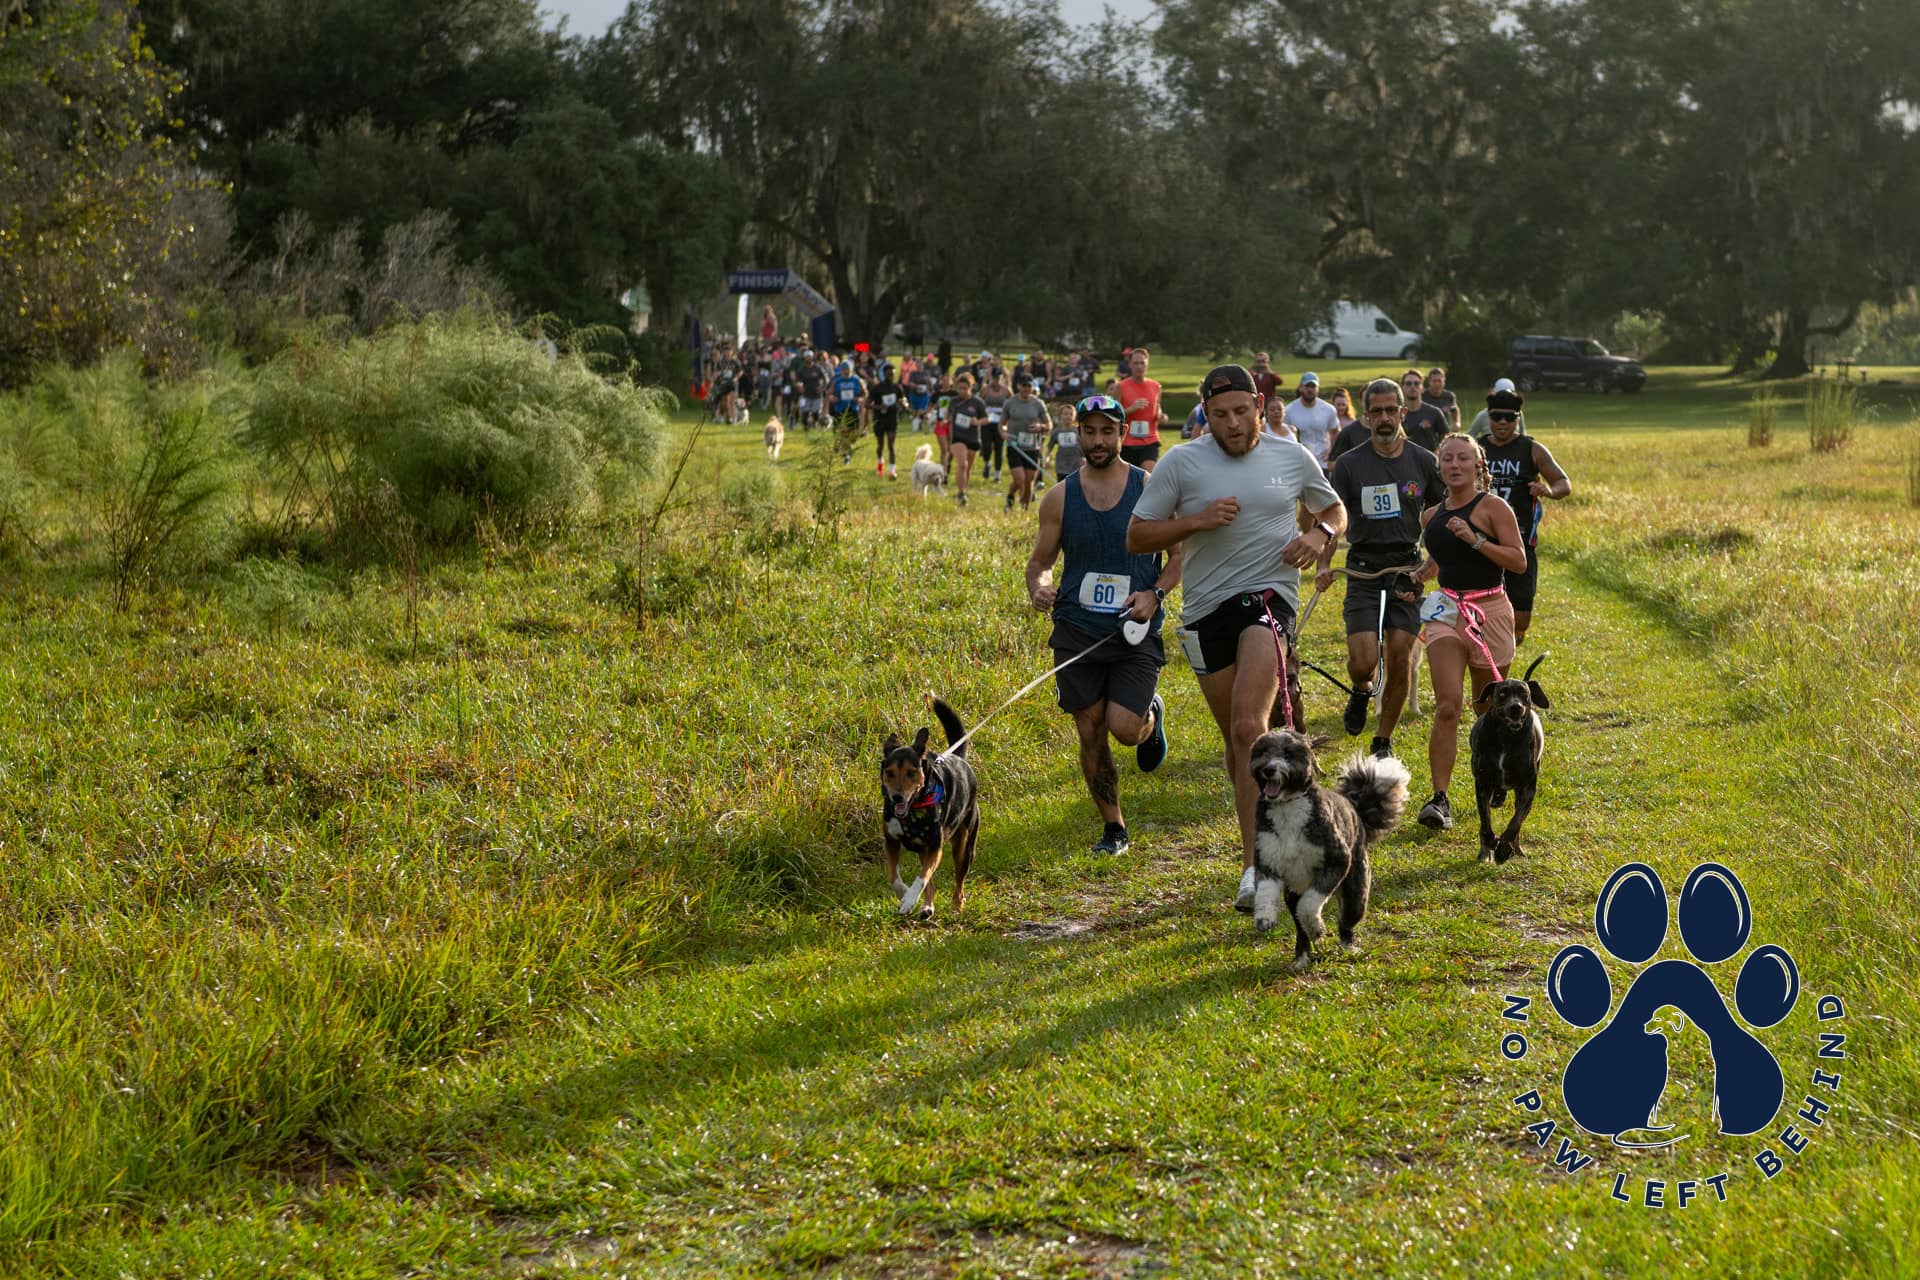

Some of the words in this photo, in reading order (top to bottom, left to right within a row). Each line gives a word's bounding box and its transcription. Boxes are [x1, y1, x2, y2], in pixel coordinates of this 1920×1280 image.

[728, 274, 785, 289] FINISH
[1373, 494, 1391, 512] 39
[1093, 583, 1115, 605] 60
[1430, 604, 1445, 621] 2
